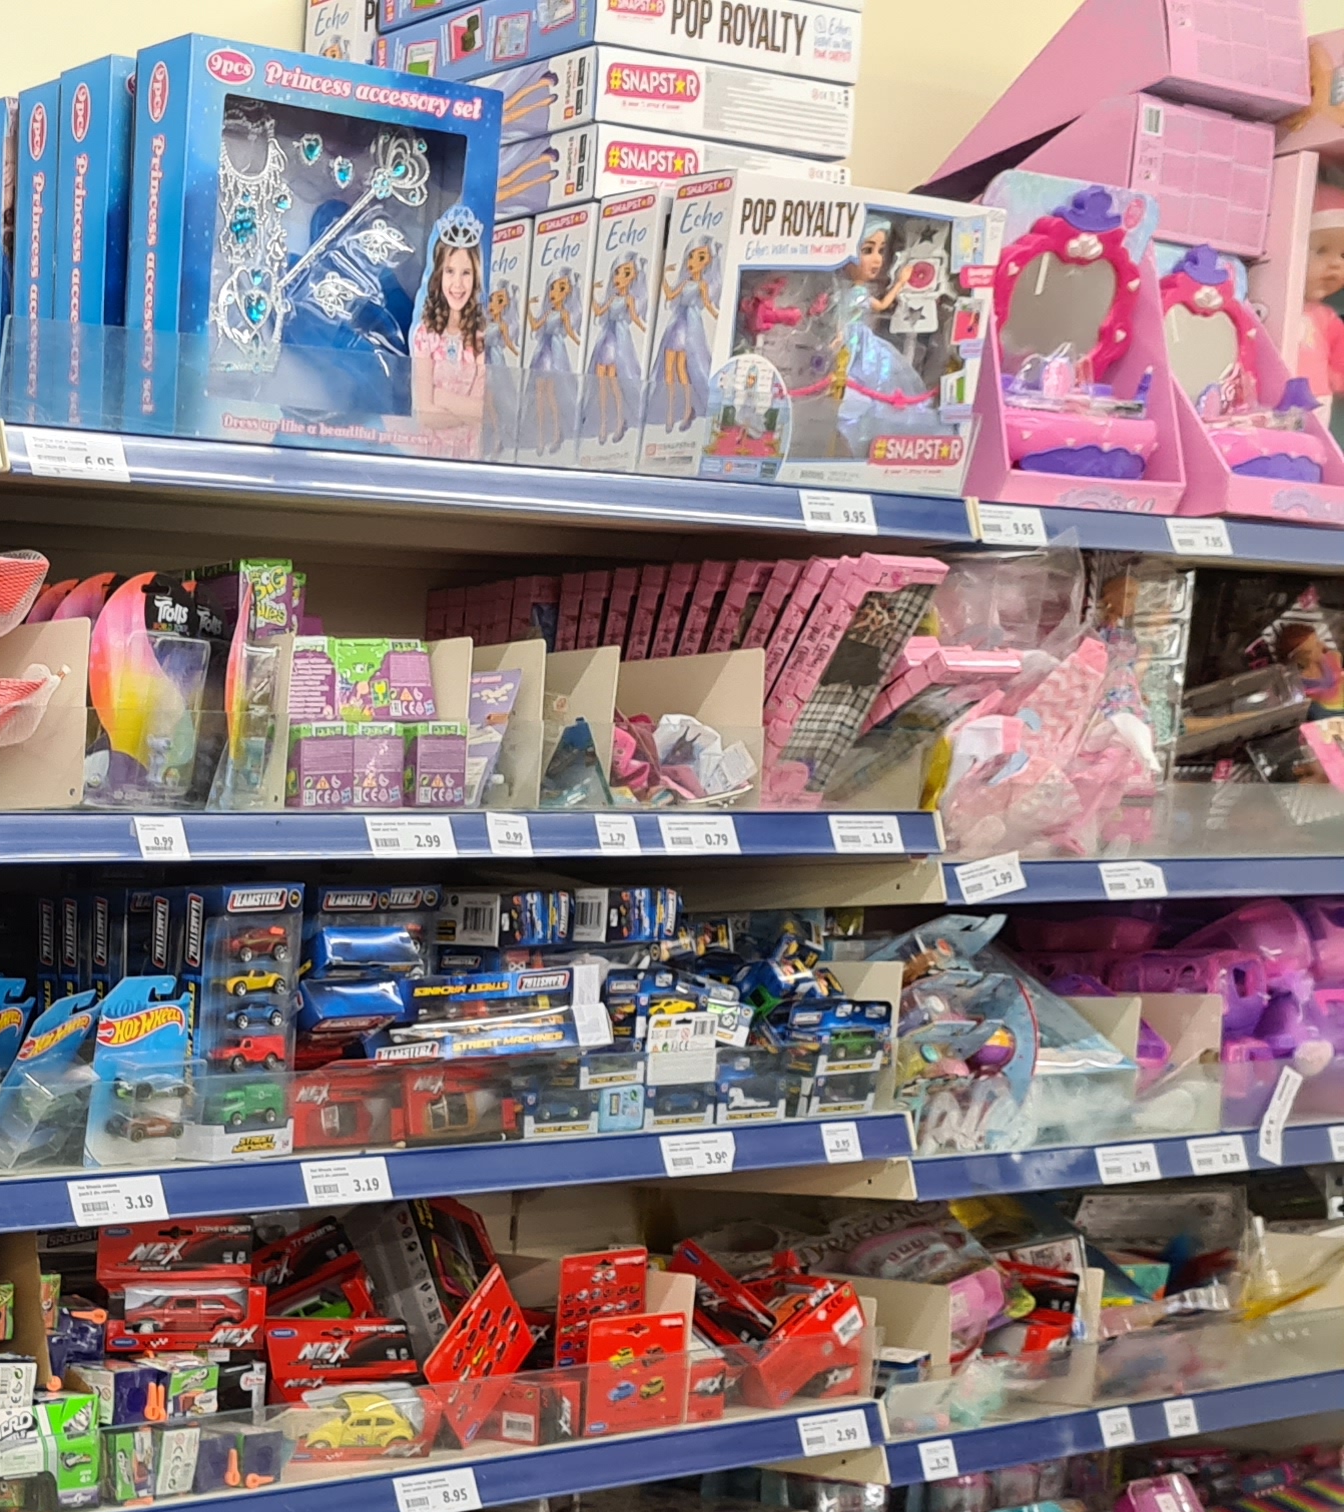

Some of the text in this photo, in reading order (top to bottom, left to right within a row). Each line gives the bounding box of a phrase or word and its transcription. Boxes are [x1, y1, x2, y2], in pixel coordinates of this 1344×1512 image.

[315, 3, 350, 38] Echo
[670, 0, 808, 57] POP ROYALTY
[208, 53, 252, 80] 9pcs
[152, 65, 167, 119] 9pcs
[266, 61, 483, 120] Princess accessory set
[75, 84, 89, 139] 9pcs
[679, 202, 723, 233] Echo
[739, 198, 859, 239] POP ROYALTY
[605, 218, 648, 250] Echo
[541, 237, 581, 268] Echo
[69, 153, 89, 384] Princess accessory
[141, 134, 165, 414] Princess accessory set
[222, 414, 376, 439] Dress like beautiful
[843, 510, 867, 524] 9.95
[154, 595, 189, 624] Trolls
[153, 836, 174, 848] 0.99
[414, 835, 441, 848] 2.99
[705, 833, 728, 846] 0.79
[872, 832, 894, 844] 1.19
[353, 1178, 380, 1193] 3.19
[124, 1194, 154, 1210] 3.19
[128, 1239, 189, 1265] NEX
[210, 1325, 259, 1347] NEX
[297, 1337, 352, 1364] NEX
[836, 1428, 857, 1442] 2.99
[442, 1488, 469, 1504] 8.95
